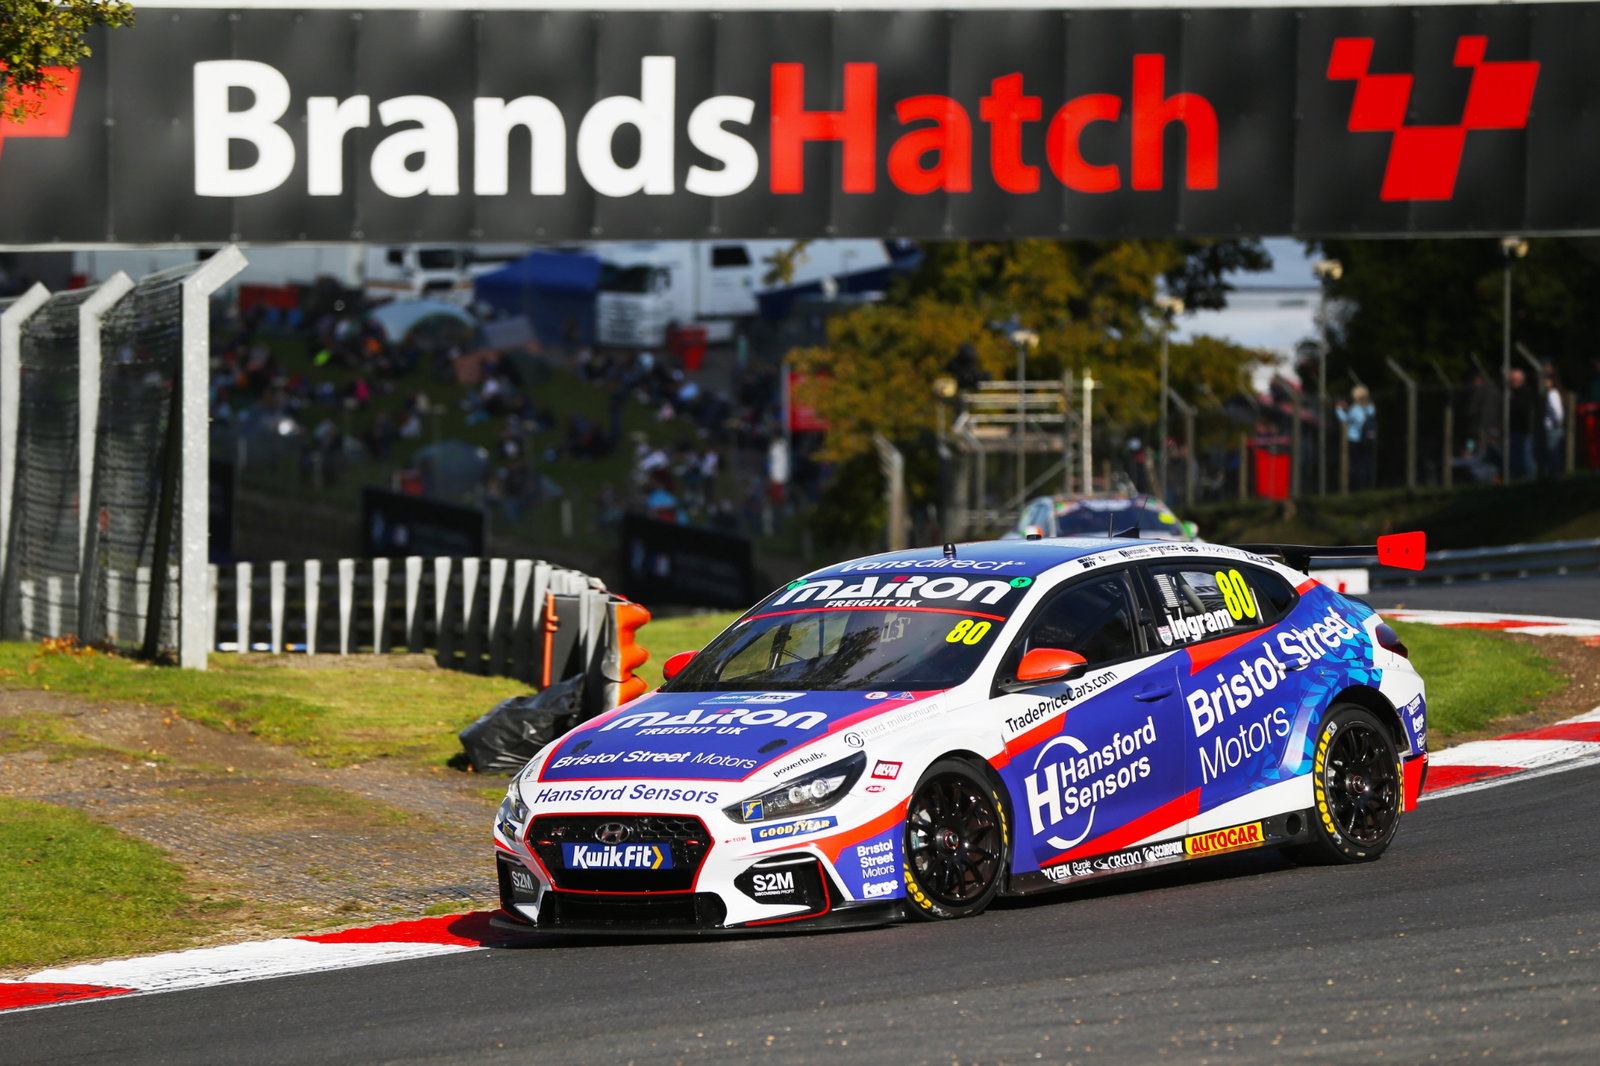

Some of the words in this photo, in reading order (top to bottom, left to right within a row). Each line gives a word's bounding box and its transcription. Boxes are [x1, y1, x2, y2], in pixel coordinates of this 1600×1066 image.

[824, 600, 893, 608] FREIGHT
[894, 600, 922, 608] UK
[1215, 569, 1257, 621] 80
[945, 619, 992, 646] 80
[1166, 608, 1234, 642] Ingram
[1186, 641, 1287, 738] Bristol
[1276, 606, 1360, 672] Street
[1005, 670, 1118, 733] TradePriceCars.com
[635, 726, 716, 737] FREIGHT
[718, 727, 750, 736] UK
[861, 723, 886, 738] third
[1060, 715, 1157, 788] Hansford
[1199, 706, 1291, 785] Motors
[551, 750, 621, 770] Bristol
[622, 749, 691, 764] Street
[690, 752, 758, 770] Motors
[773, 751, 828, 778] powerbulbs
[535, 786, 628, 804] Hansford
[629, 784, 720, 804] Sensors
[1064, 756, 1151, 815] Sensors
[759, 819, 831, 838] GOODYEAR
[1191, 824, 1259, 854] AUTOCAR
[857, 838, 894, 857] Bristol
[860, 851, 895, 868] Street
[1108, 850, 1142, 870] CREDO
[511, 871, 534, 890] S2M
[752, 871, 795, 892] S2M
[862, 865, 896, 879] Motors
